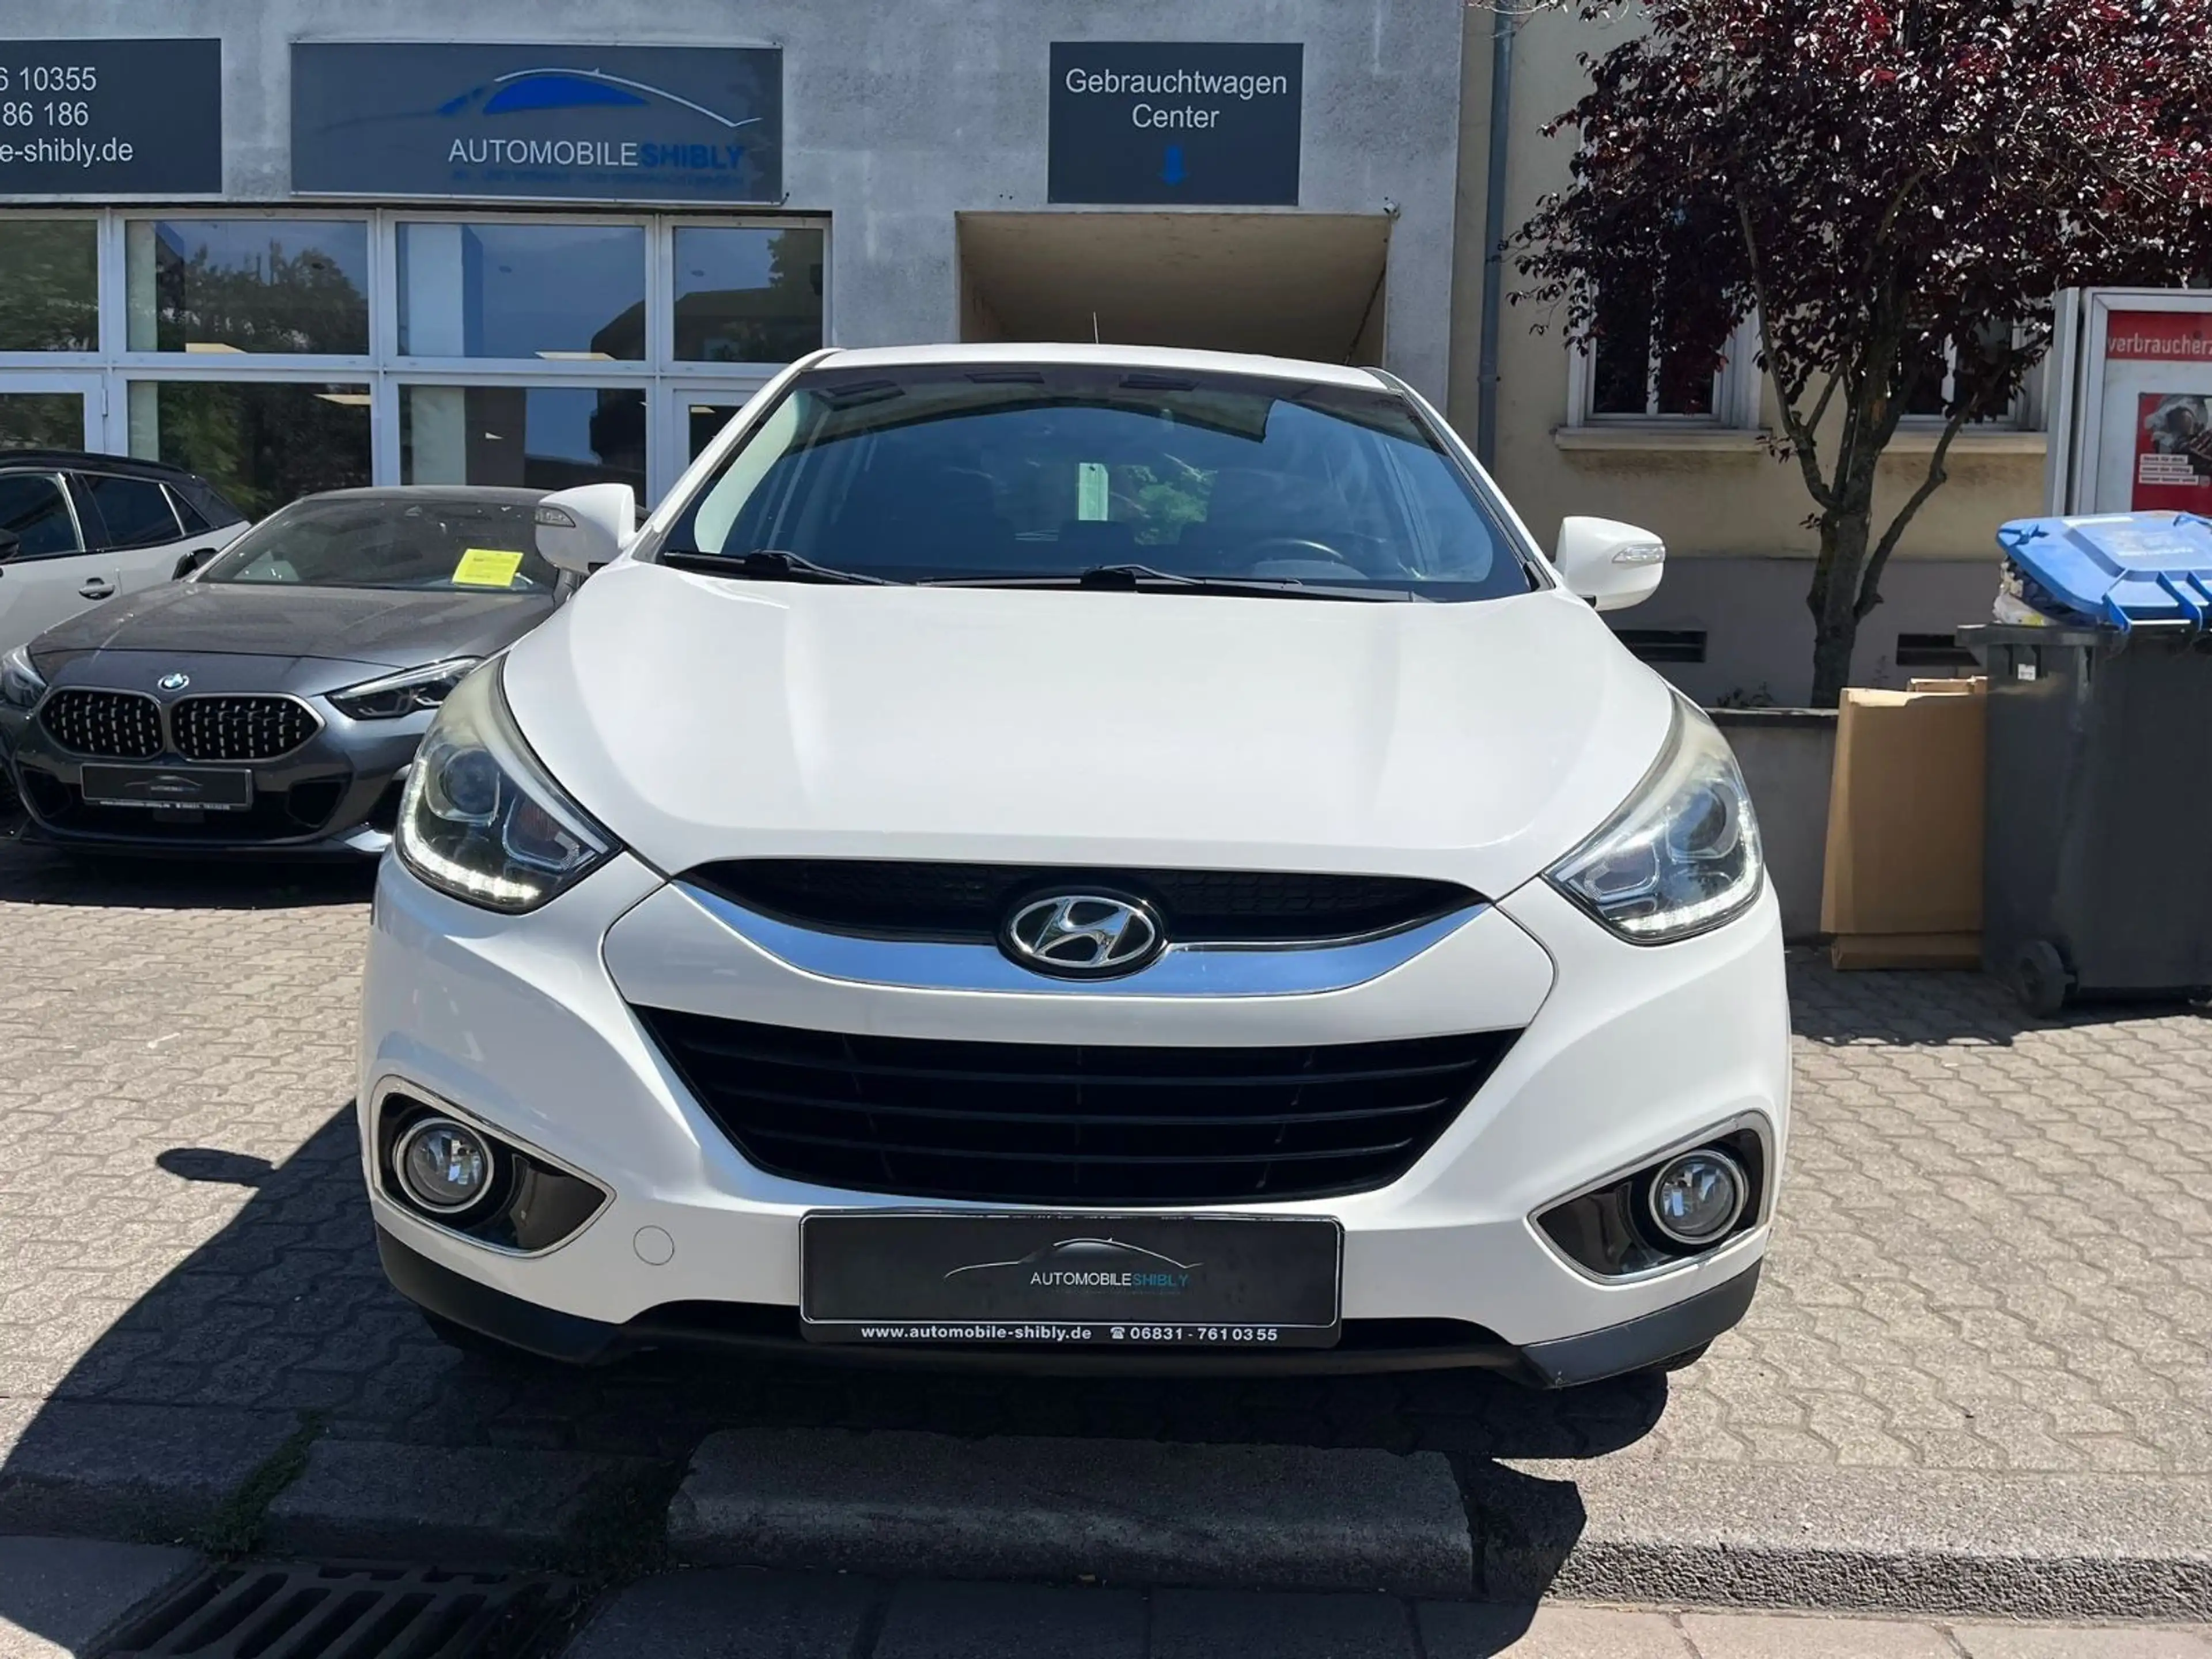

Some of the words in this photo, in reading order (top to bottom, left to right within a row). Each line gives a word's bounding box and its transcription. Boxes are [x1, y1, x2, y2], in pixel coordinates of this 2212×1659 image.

[19, 67, 97, 91] 10355
[1066, 68, 1287, 100] Gebrauchtwagen
[3, 102, 33, 126] 86
[44, 102, 89, 126] 186
[1132, 103, 1219, 128] Center
[0, 137, 134, 168] e-shibly.de
[861, 1325, 1092, 1342] www.automobile-shibly.de
[1130, 1327, 1182, 1340] 06831
